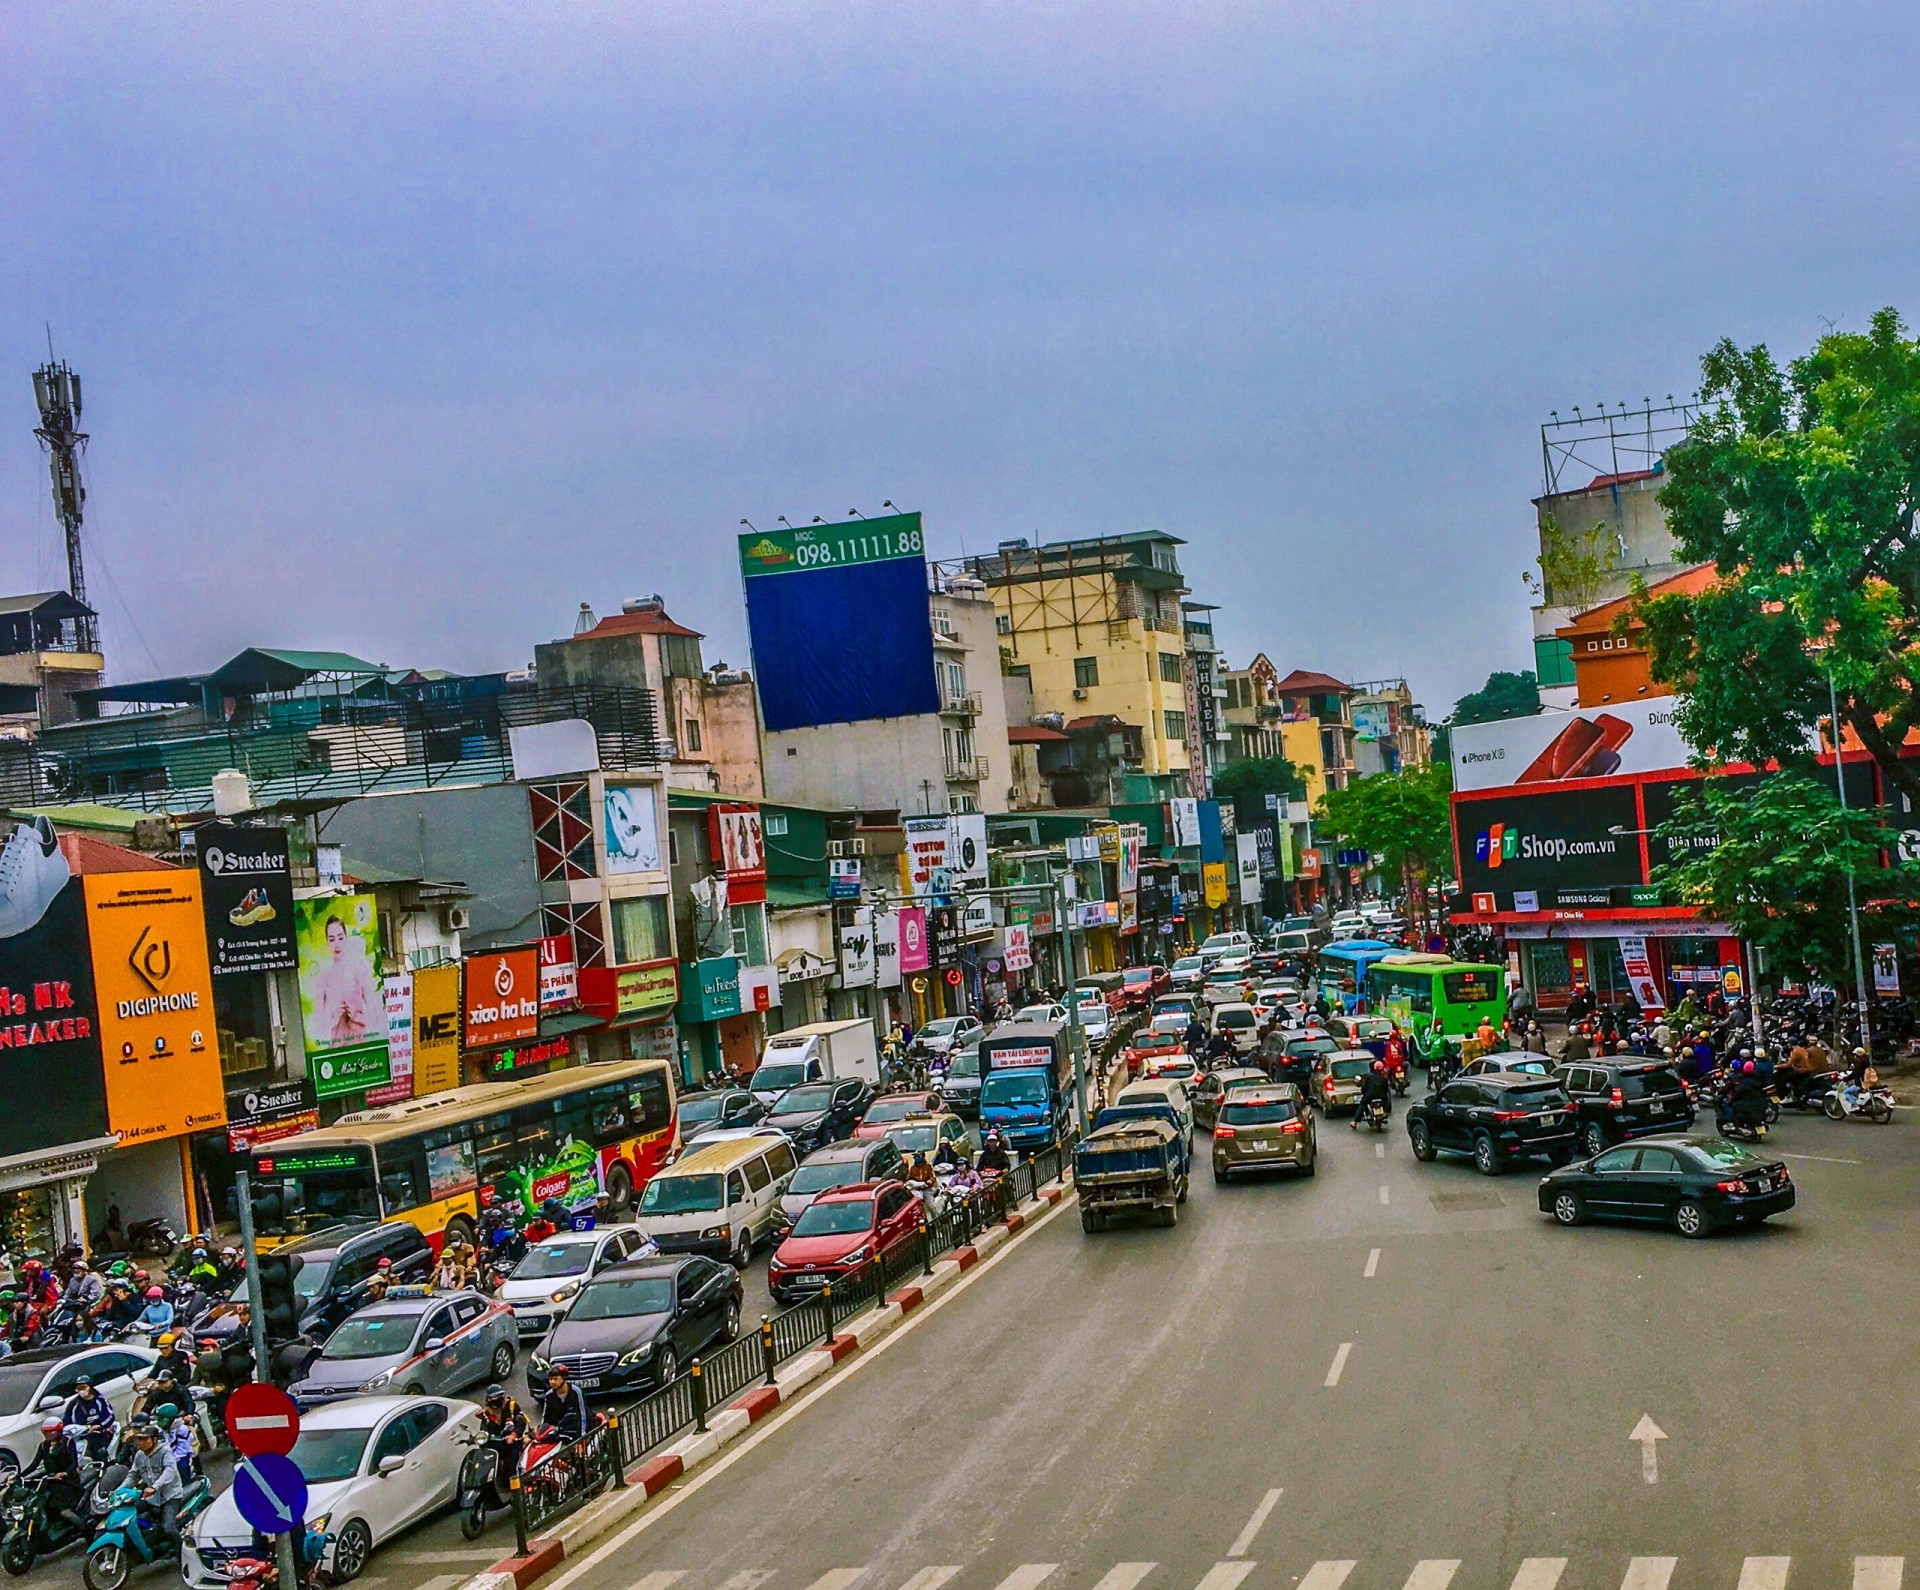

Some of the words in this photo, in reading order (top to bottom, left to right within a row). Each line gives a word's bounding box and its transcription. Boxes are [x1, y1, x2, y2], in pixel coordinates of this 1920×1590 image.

[795, 531, 816, 542] MQC:
[797, 530, 922, 566] 098.11111.88
[1199, 672, 1214, 731] HOTEL
[1468, 750, 1491, 763] iPhone
[1522, 833, 1615, 863] Shop.com.vn
[1694, 833, 1721, 848] thoại
[225, 851, 286, 871] Sneaker
[1557, 895, 1587, 904] SAMSUNG
[1588, 894, 1610, 905] Galaxy
[118, 991, 200, 1018] DIGIPHONE
[501, 1000, 519, 1019] ha
[520, 997, 537, 1017] ha
[419, 1011, 457, 1042] ME
[260, 1090, 303, 1109] Sneaker
[124, 1127, 140, 1140] 144
[535, 1179, 567, 1198] Colgate
